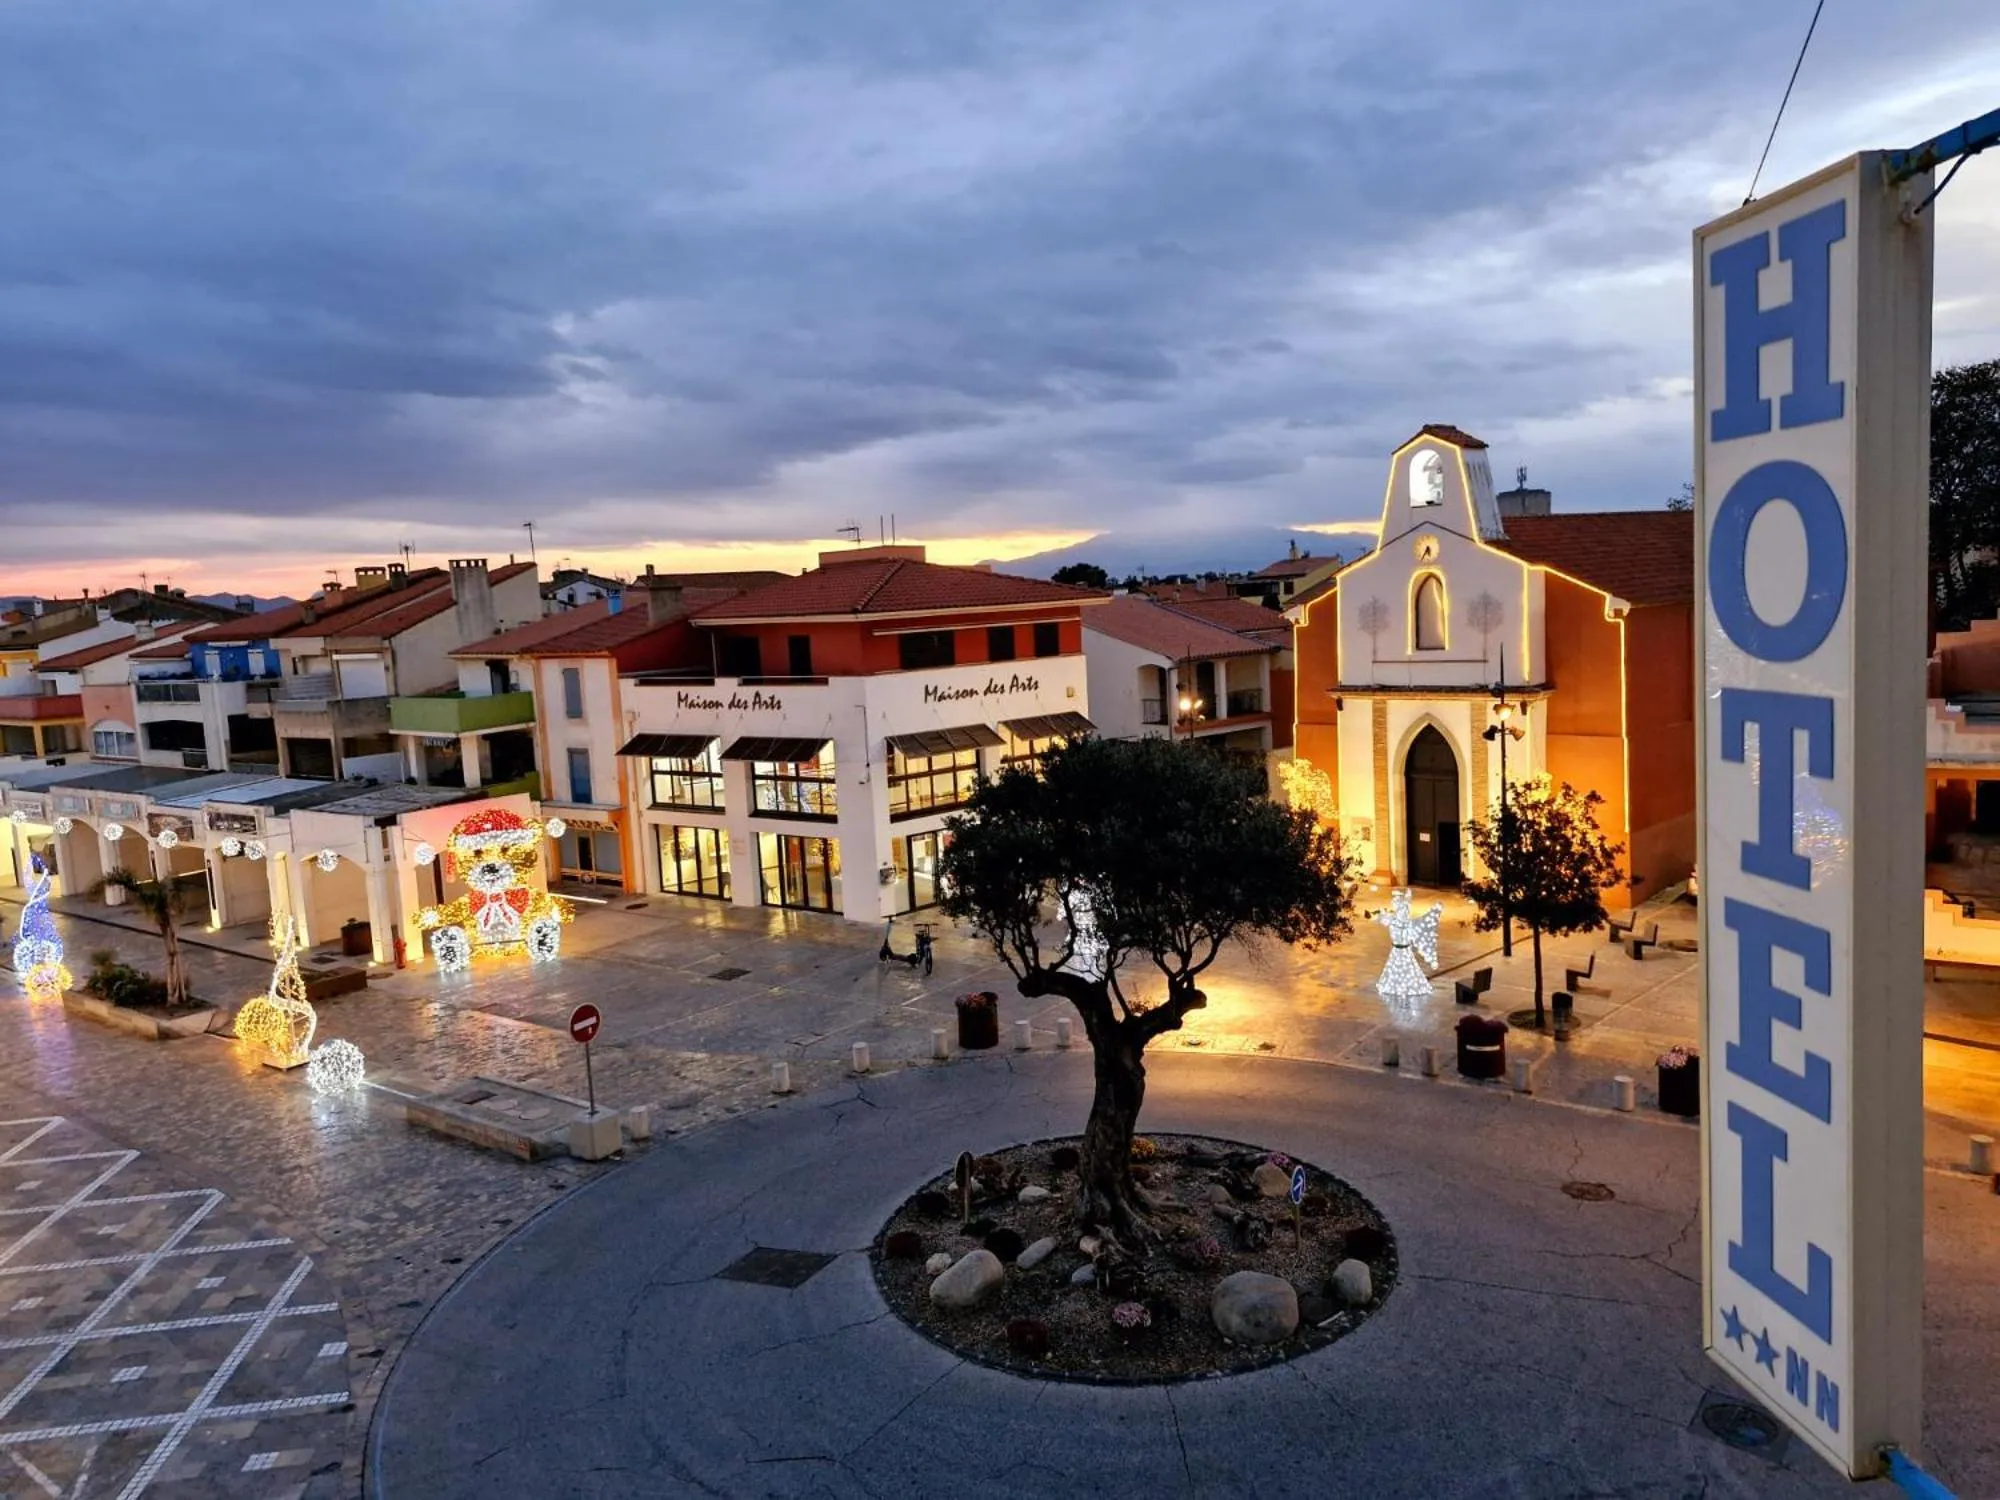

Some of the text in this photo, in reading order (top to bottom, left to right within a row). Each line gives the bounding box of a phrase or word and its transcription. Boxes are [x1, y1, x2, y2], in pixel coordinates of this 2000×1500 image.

[677, 690, 782, 712] Maison des Arts
[923, 673, 1039, 704] Maison des Arts
[1708, 199, 1848, 1346] HOTEL
[1785, 1345, 1839, 1434] NN
